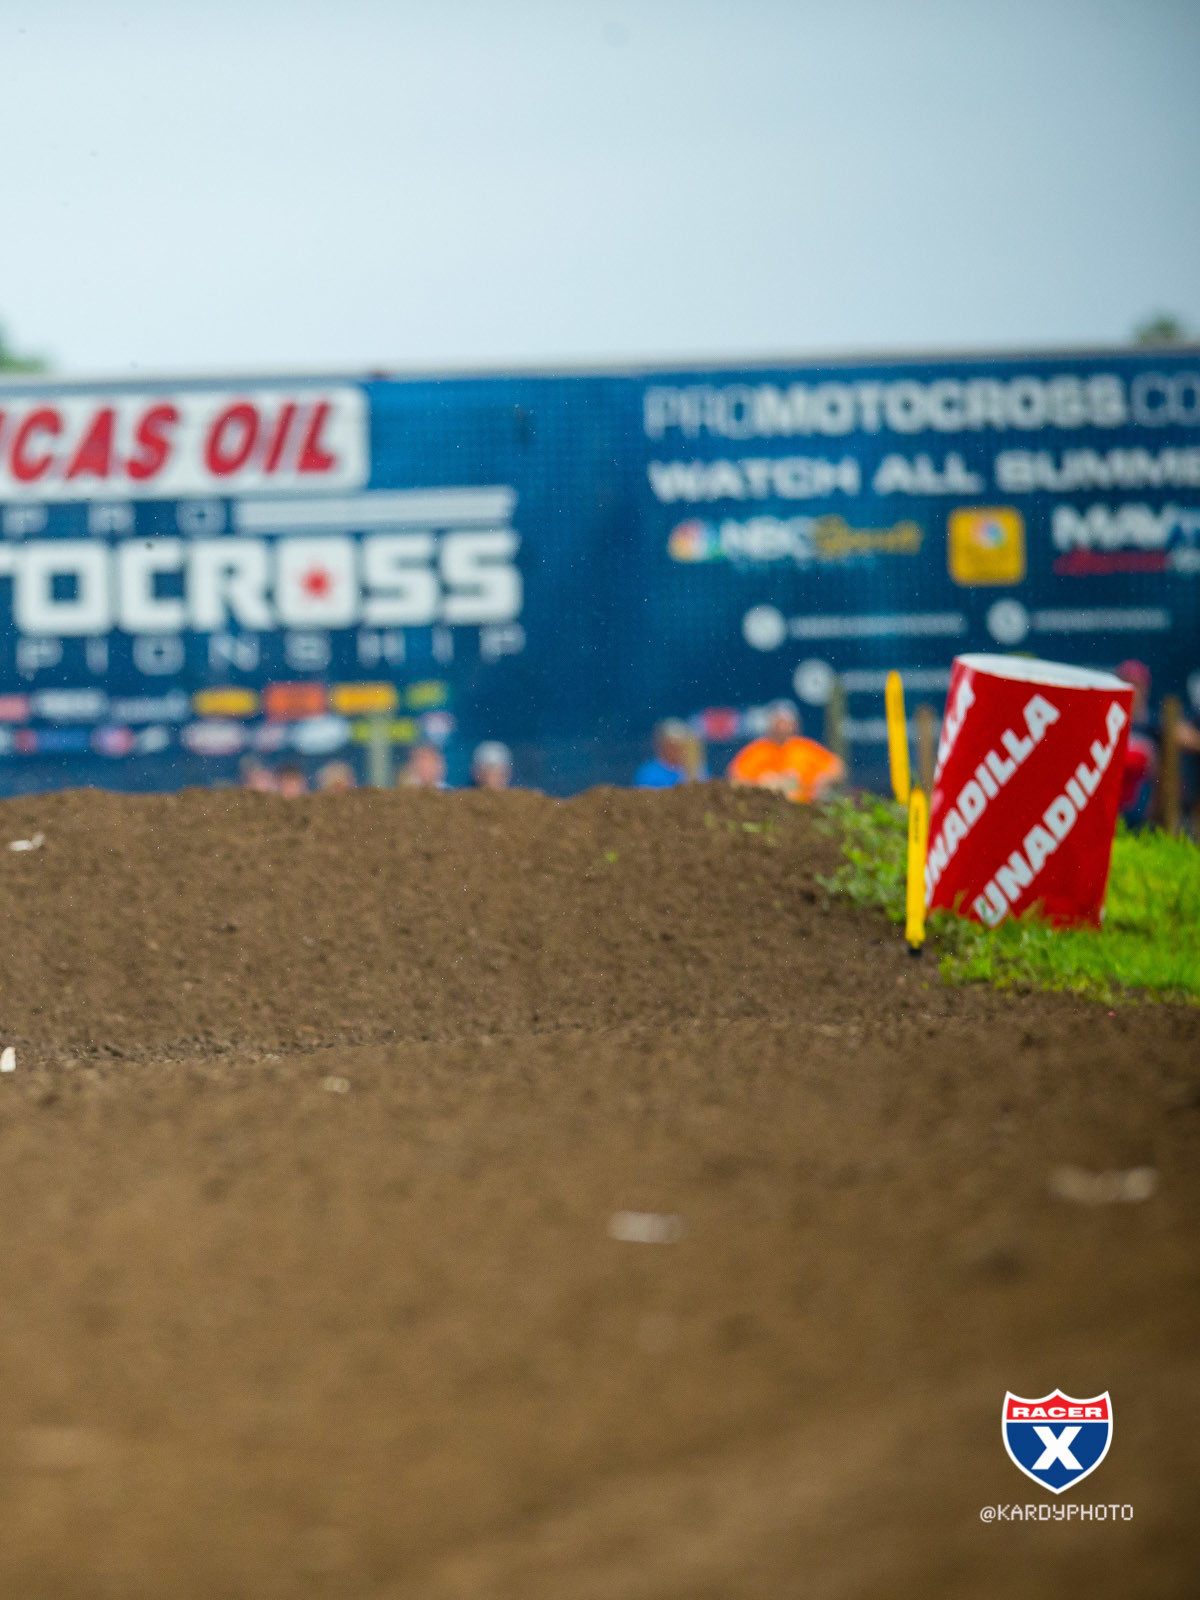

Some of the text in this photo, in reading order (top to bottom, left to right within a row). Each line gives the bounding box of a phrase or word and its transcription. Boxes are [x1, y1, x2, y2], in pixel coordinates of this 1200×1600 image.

[205, 399, 337, 476] OIL
[648, 454, 861, 502] WATCH
[873, 451, 986, 495] ALL
[2, 497, 228, 540] PRO
[971, 700, 1128, 927] UNADILLA
